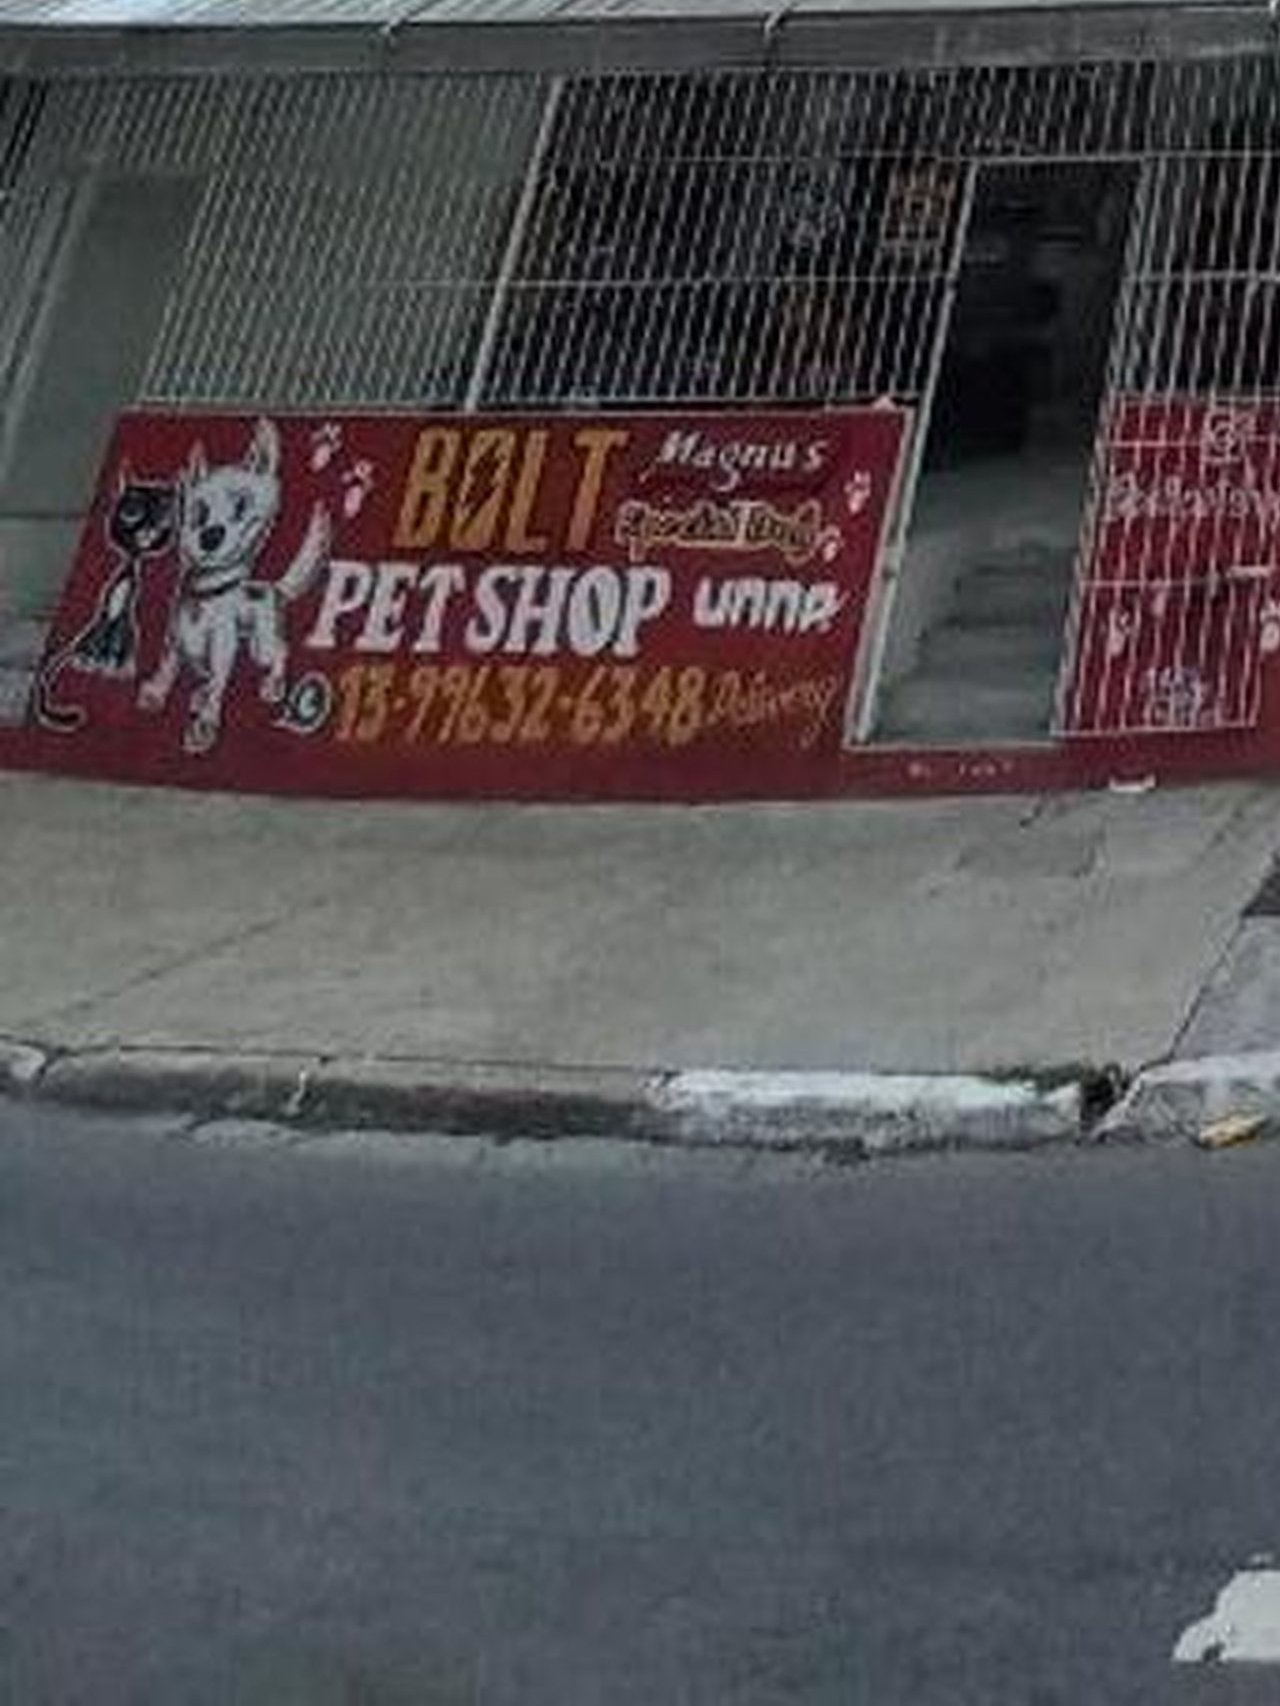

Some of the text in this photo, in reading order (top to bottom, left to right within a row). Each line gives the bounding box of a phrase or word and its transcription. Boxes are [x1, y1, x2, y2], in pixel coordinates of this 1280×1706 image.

[393, 426, 630, 553] BOLT
[304, 559, 672, 658] PET SHOP
